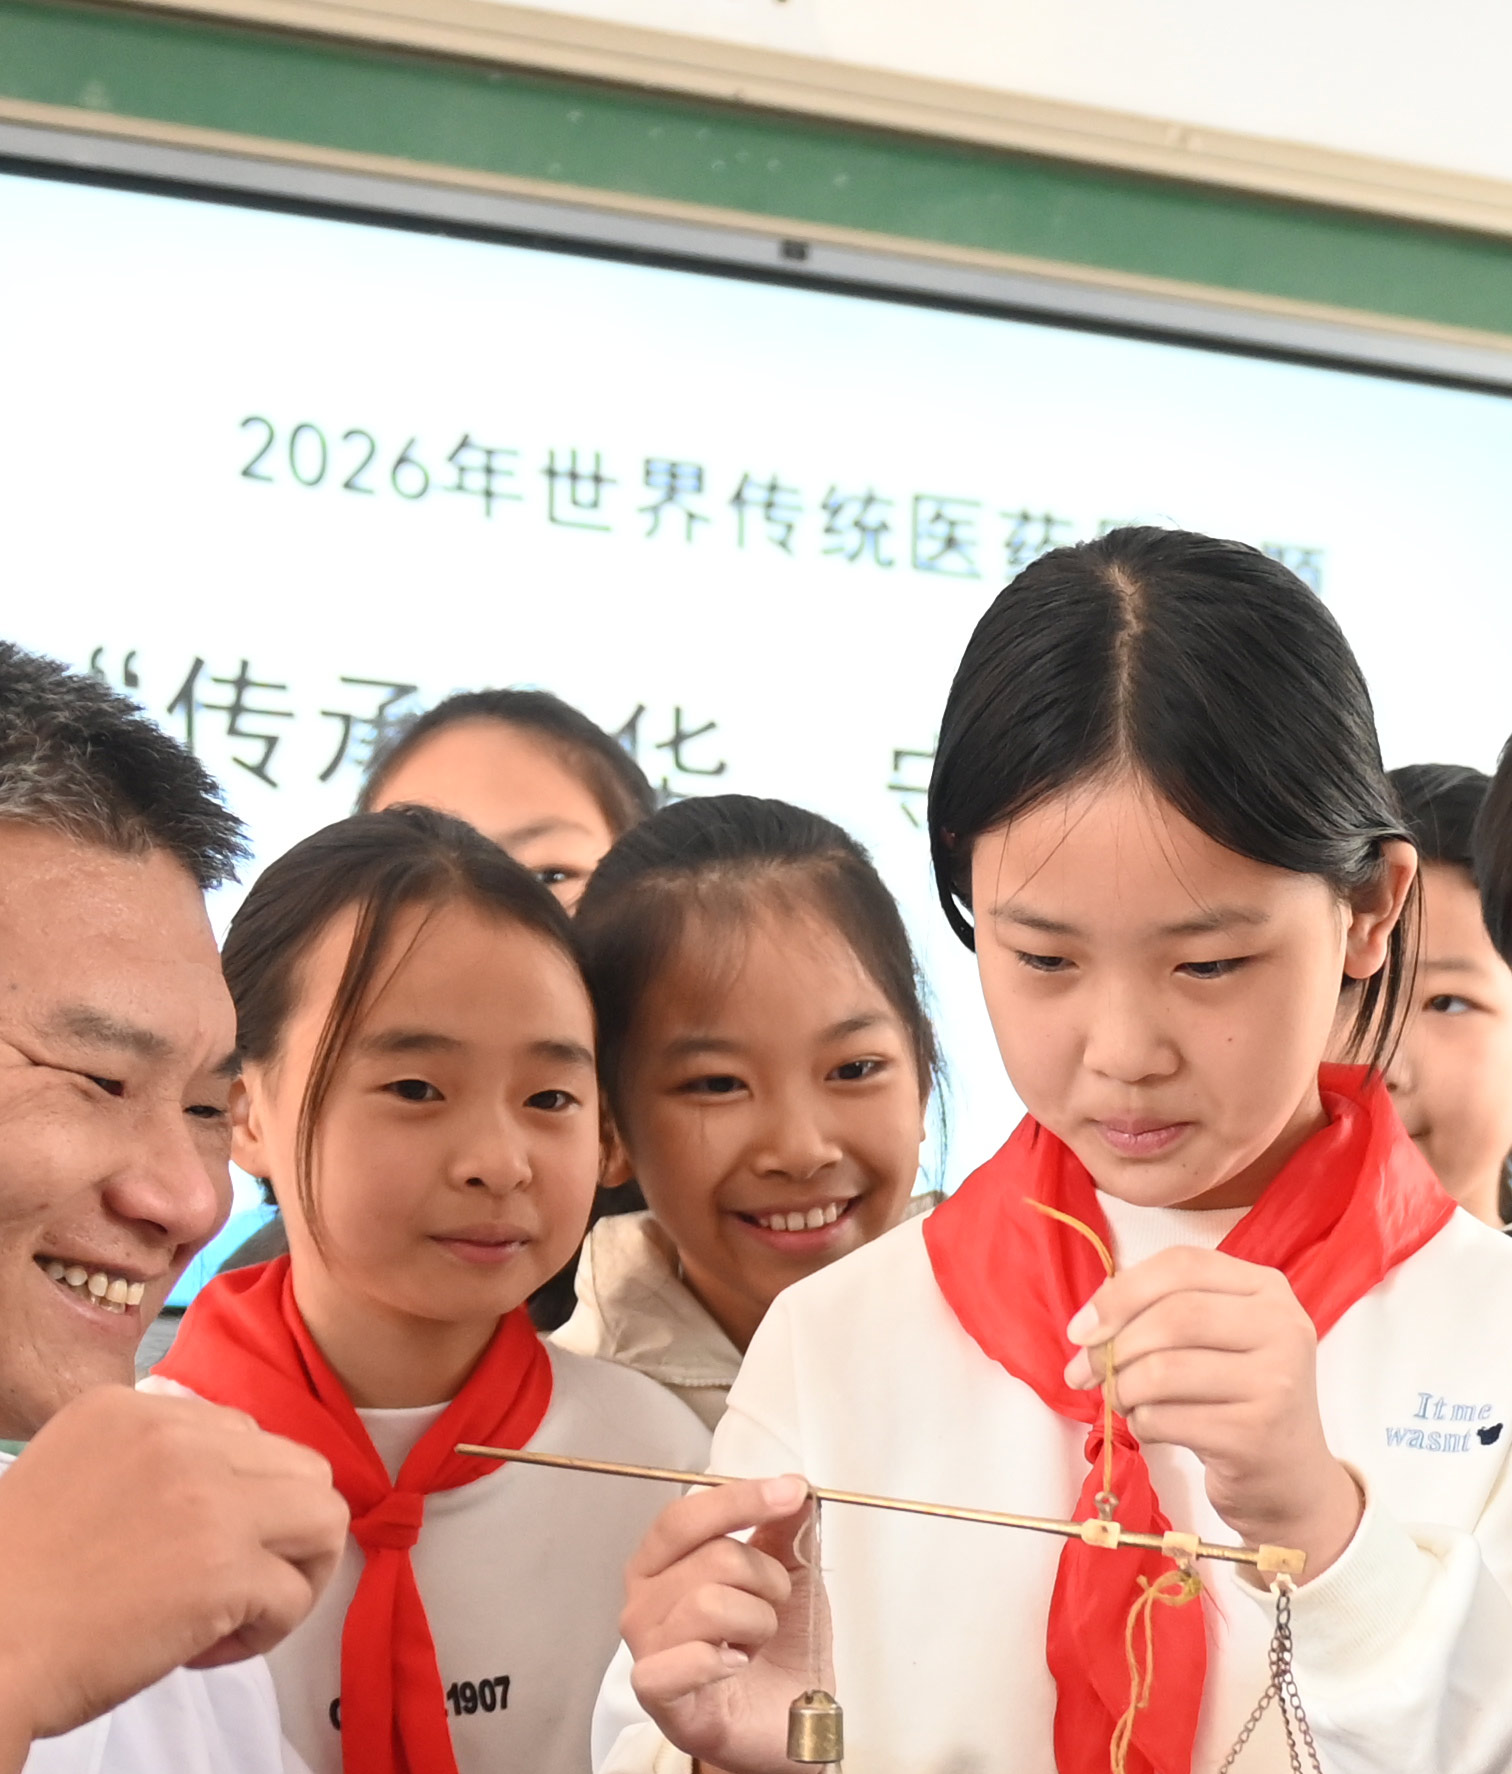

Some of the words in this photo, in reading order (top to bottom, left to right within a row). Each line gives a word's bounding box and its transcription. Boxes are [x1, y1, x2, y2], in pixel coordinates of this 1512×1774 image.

[240, 414, 1326, 598] 2026年世界传统医药
[1414, 1392, 1447, 1420] It
[1386, 1427, 1471, 1452] wasnt
[446, 1675, 510, 1716] 1907
